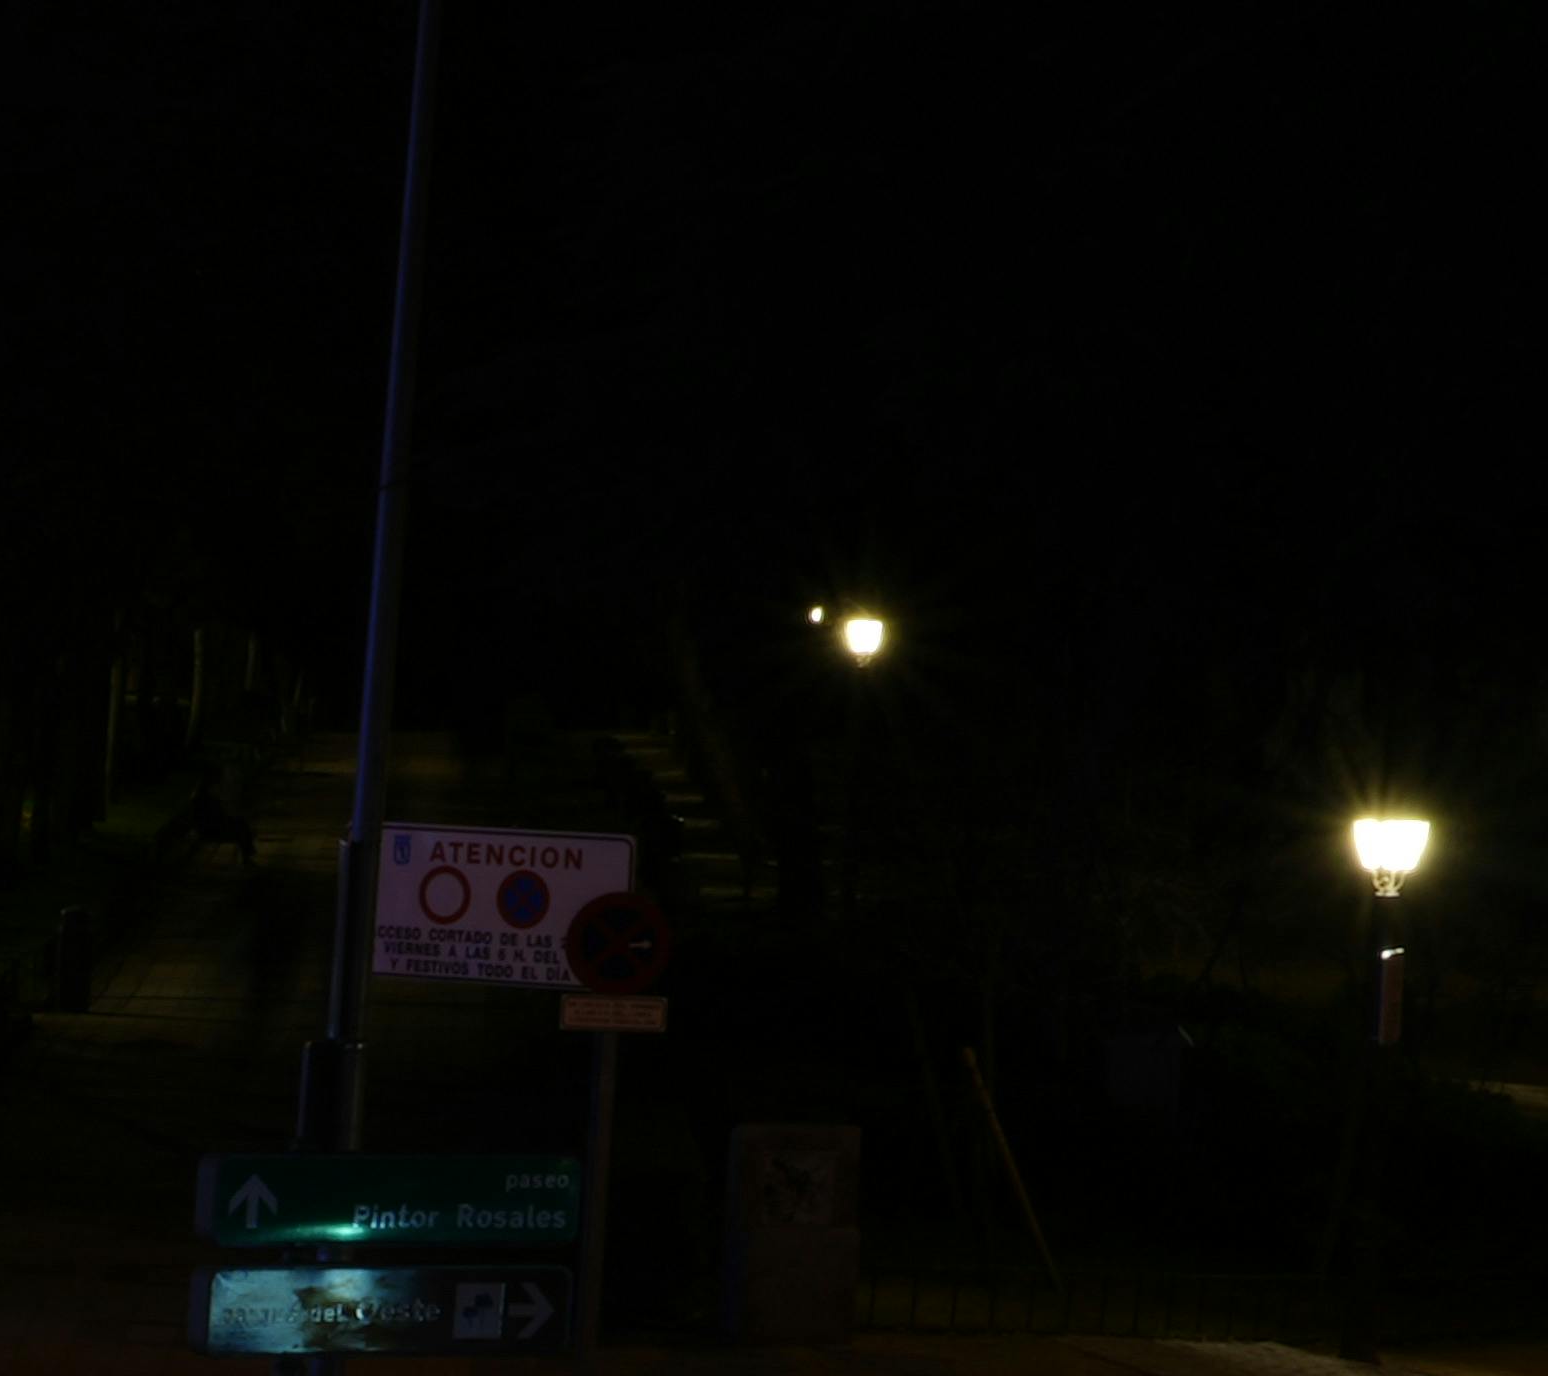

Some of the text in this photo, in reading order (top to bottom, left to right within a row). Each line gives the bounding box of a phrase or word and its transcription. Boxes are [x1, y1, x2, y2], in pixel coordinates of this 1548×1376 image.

[430, 841, 583, 870] ATENCION
[378, 925, 421, 940] CCESO
[429, 928, 493, 945] CORTADO
[500, 932, 518, 947] DE
[527, 934, 552, 949] LAS
[383, 940, 441, 957] VIERNES
[448, 944, 458, 957] A
[466, 945, 490, 960] LAS
[534, 950, 559, 964] DEL
[390, 958, 399, 971] Y
[406, 958, 469, 975] FESTIVOS
[477, 963, 514, 979] TODO
[522, 965, 539, 980] EL
[505, 1172, 571, 1193] paseo
[352, 1202, 568, 1230] Pintor Rosales
